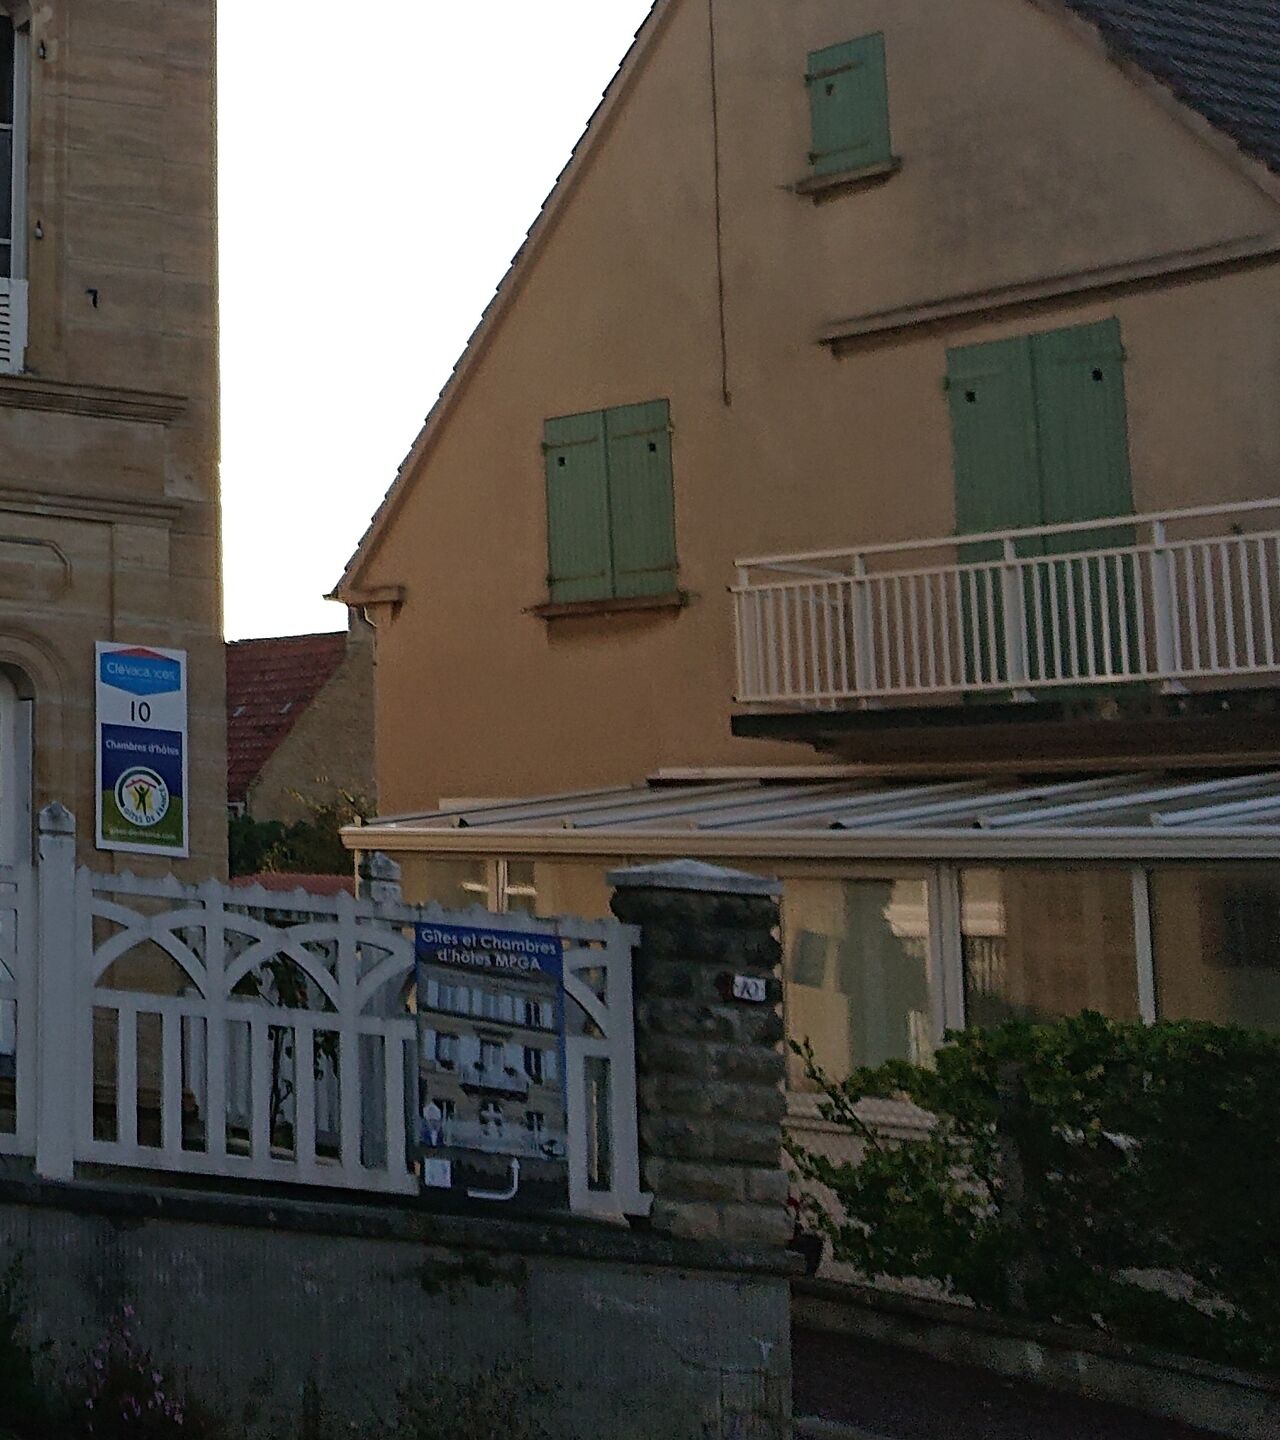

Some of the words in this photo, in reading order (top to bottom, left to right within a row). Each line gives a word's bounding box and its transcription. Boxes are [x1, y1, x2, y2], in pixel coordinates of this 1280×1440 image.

[131, 701, 151, 722] 10
[106, 739, 147, 752] Chambres
[148, 743, 180, 755] d'hôtes
[421, 929, 458, 945] Gîtes
[462, 933, 476, 947] et
[480, 935, 557, 955] Chambres
[436, 947, 492, 966] d'hôtes
[495, 953, 541, 971] MPGA
